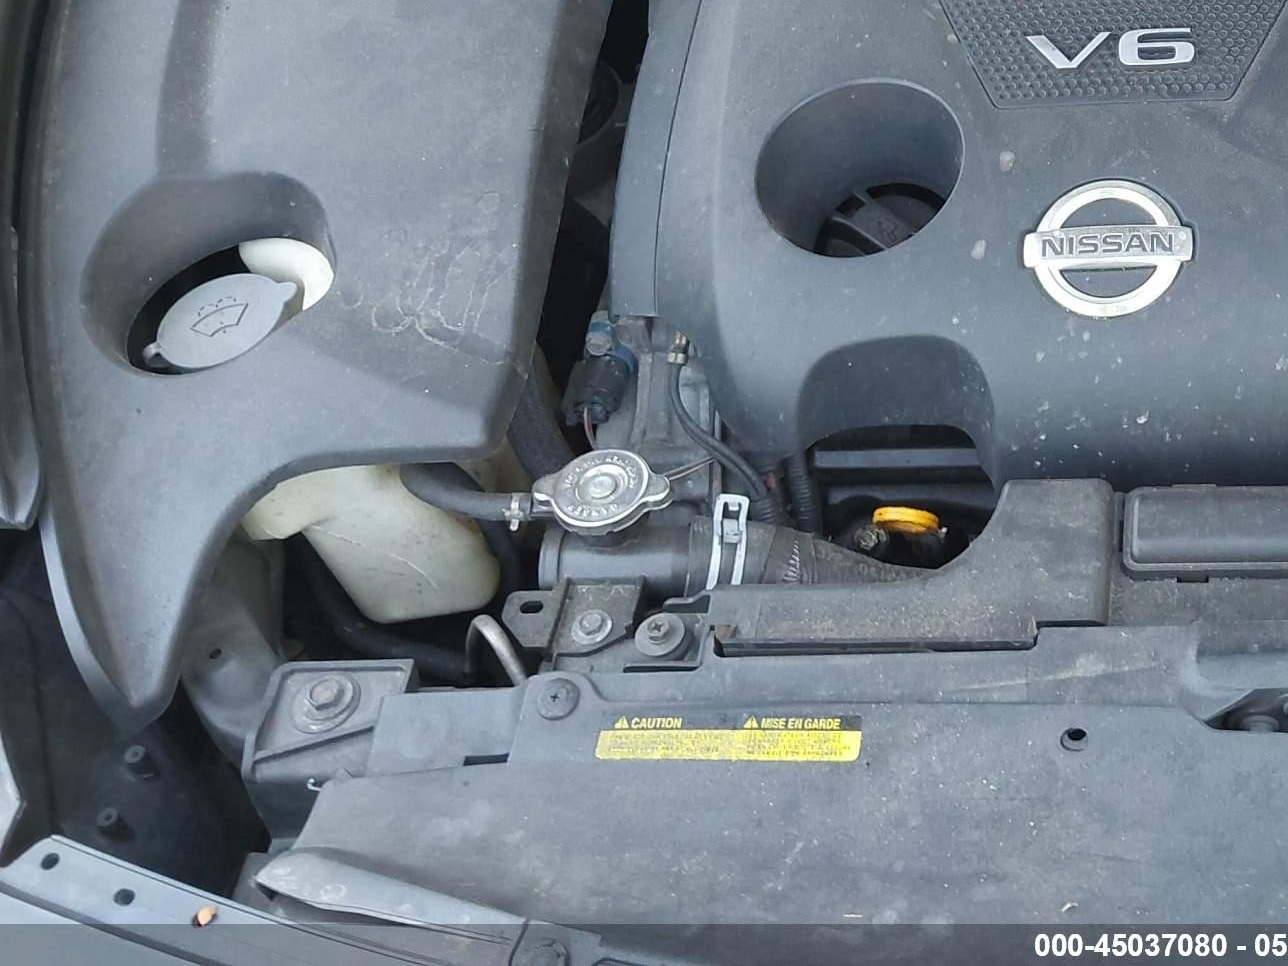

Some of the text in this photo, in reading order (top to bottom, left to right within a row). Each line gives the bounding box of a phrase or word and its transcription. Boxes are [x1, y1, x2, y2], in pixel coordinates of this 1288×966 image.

[1025, 27, 1195, 69] V6
[1040, 231, 1174, 259] NISSAN
[630, 717, 682, 730] CAUTION
[760, 717, 841, 731] MISE EN GARDE
